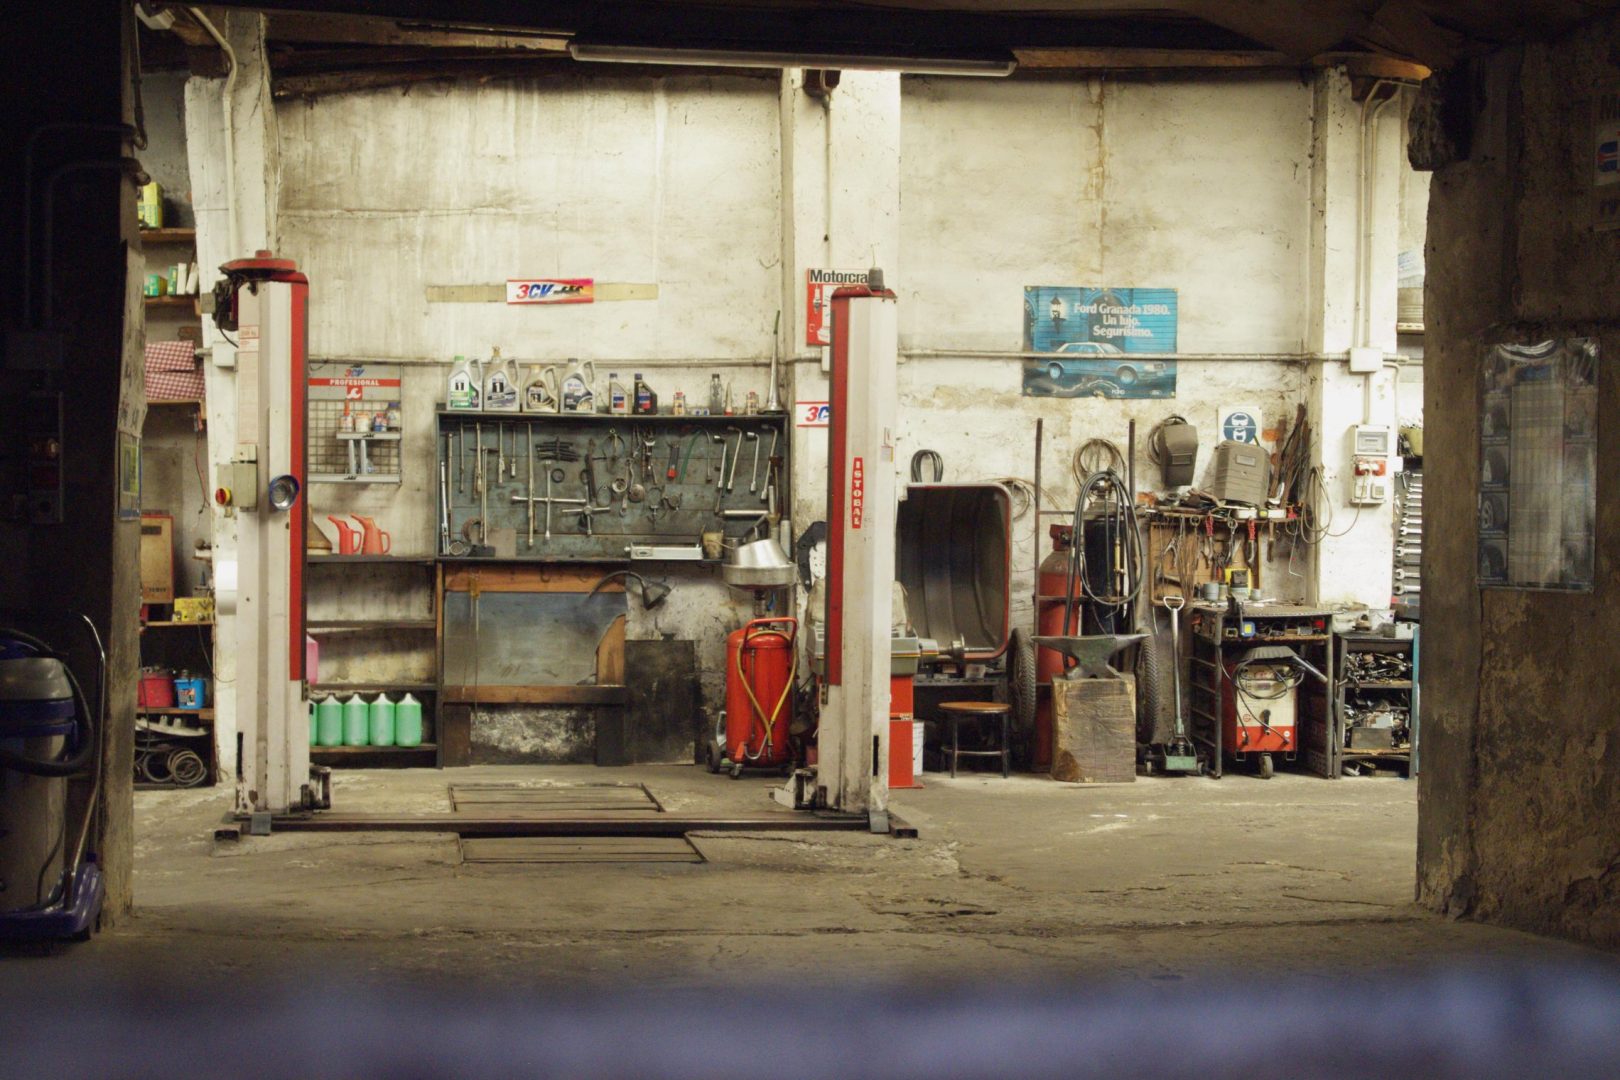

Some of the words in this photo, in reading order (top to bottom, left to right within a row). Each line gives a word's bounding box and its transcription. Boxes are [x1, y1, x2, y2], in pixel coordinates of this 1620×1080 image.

[809, 269, 870, 284] Motorcra
[516, 283, 555, 300] 3CV
[1074, 303, 1097, 314] Ford
[1099, 303, 1141, 314] Granada
[1103, 314, 1117, 325] Un
[805, 406, 830, 422] 3C
[853, 460, 862, 525] ISTOBAL
